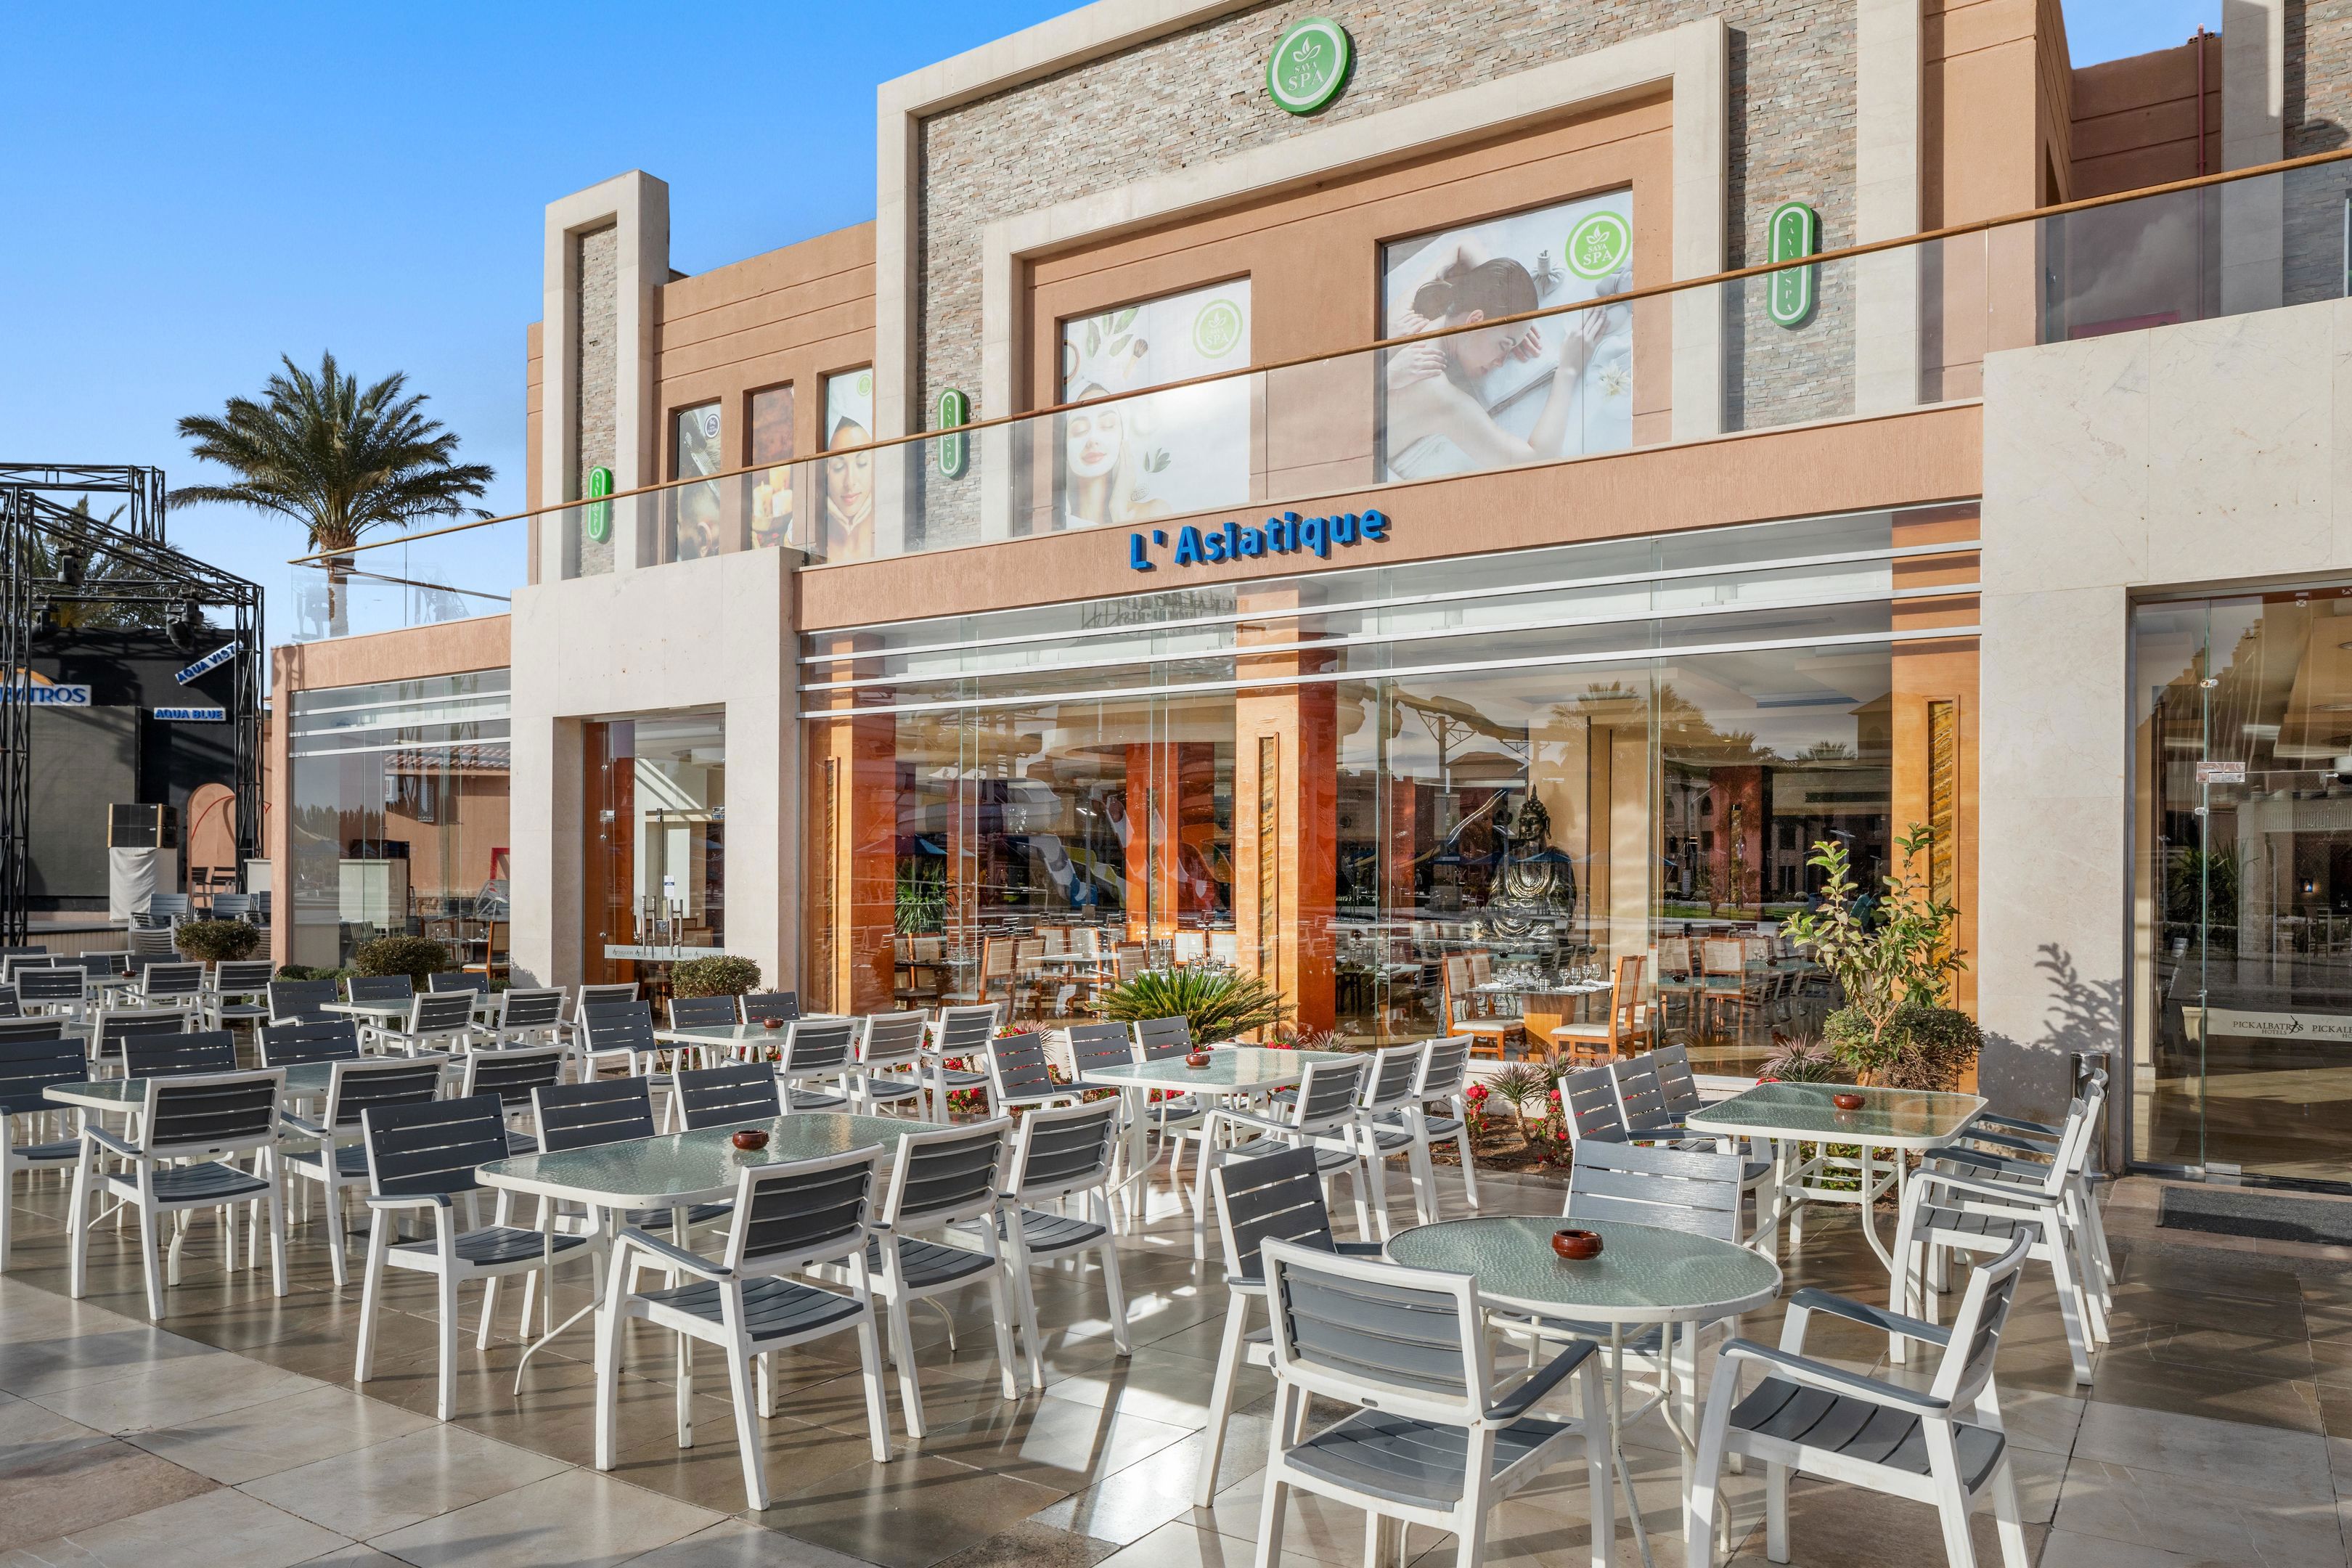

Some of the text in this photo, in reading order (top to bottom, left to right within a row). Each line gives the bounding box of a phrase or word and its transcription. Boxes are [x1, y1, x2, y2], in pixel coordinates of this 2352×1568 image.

[1294, 61, 1318, 73] SAYA
[1288, 70, 1324, 91] SPA
[1588, 243, 1607, 253] SAYA
[1583, 250, 1613, 266] SPA
[1206, 332, 1229, 346] SPA
[177, 642, 243, 682] AQUA VIST
[155, 709, 223, 719] AQUA BLUE
